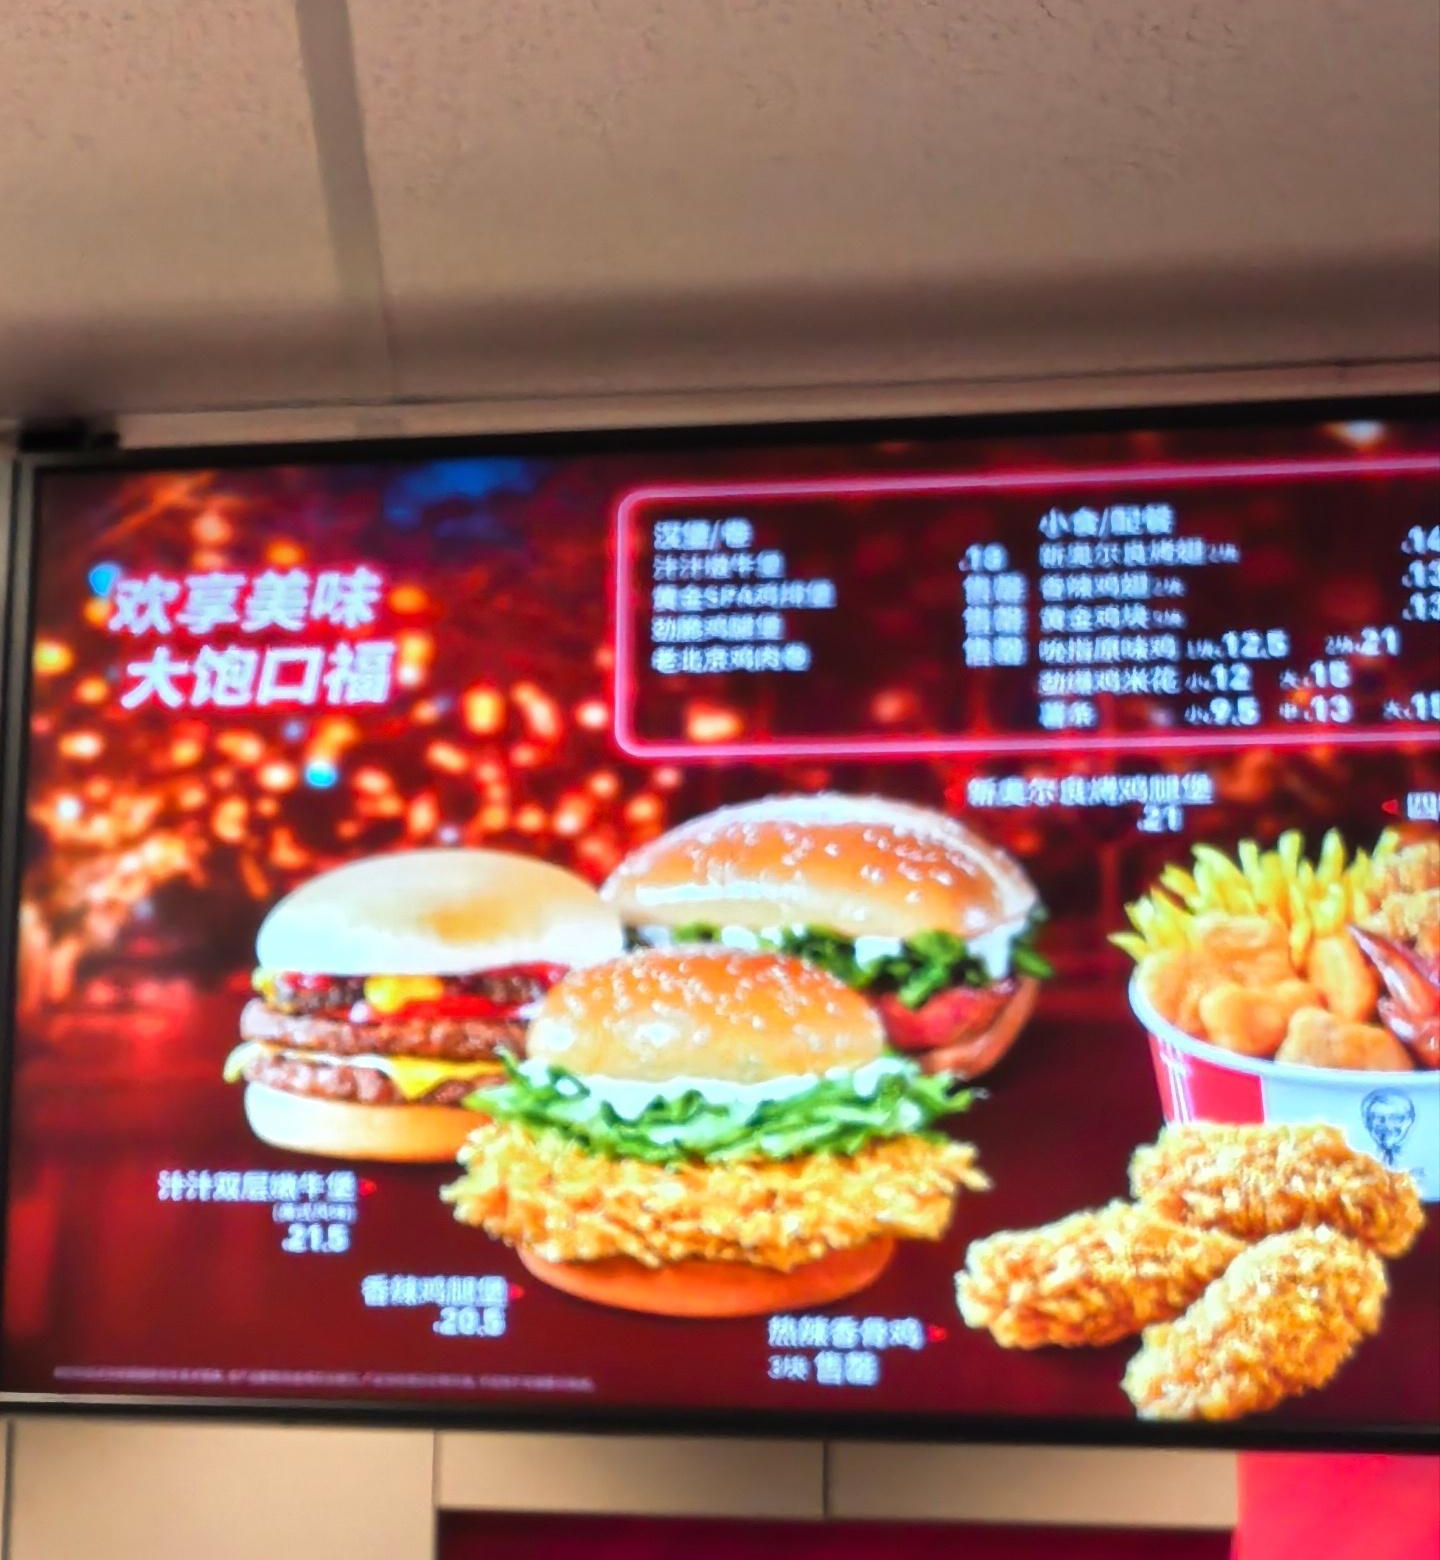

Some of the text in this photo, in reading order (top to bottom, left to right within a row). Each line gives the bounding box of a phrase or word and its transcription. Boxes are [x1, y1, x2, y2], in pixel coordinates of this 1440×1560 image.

[109, 567, 382, 635] 欢享美味
[120, 641, 396, 709] 大饱口福
